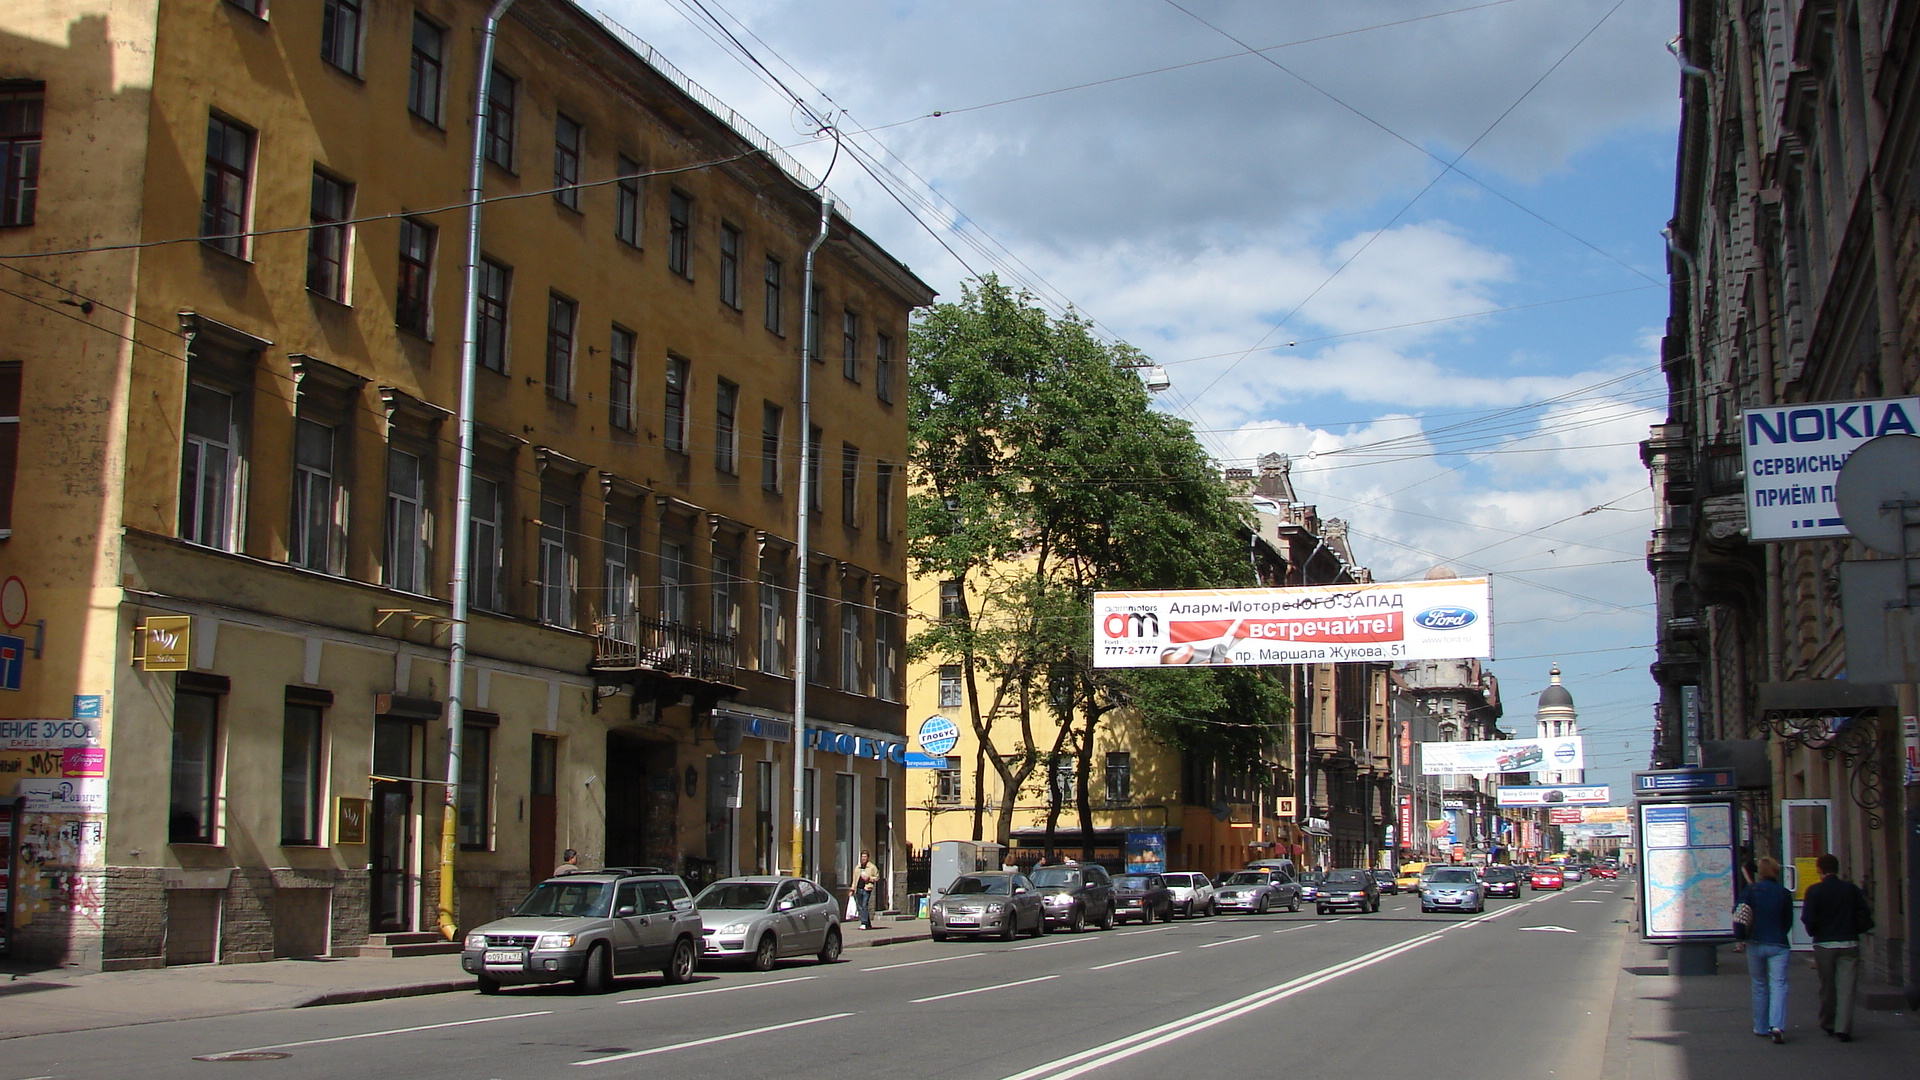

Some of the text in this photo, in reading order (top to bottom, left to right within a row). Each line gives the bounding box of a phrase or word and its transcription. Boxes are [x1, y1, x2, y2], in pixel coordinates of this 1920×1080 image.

[1747, 403, 1916, 446] NOKIA
[1753, 450, 1853, 476] СЕРВИСНЫ
[1755, 484, 1816, 507] ПРИЁМ
[1297, 593, 1404, 610] ЮГО-ЗАПАД
[1249, 614, 1393, 641] встречайте!
[1424, 609, 1467, 626] Ford
[1104, 646, 1158, 655] 777-2-777
[1235, 644, 1406, 664] пр. Маршала Жукова, 51
[0, 722, 38, 738] ЕНИЕ
[922, 729, 955, 742] ГЛОБУС
[1687, 692, 1696, 758] ТЕХНИКА
[804, 727, 905, 764] ГЛОБУС
